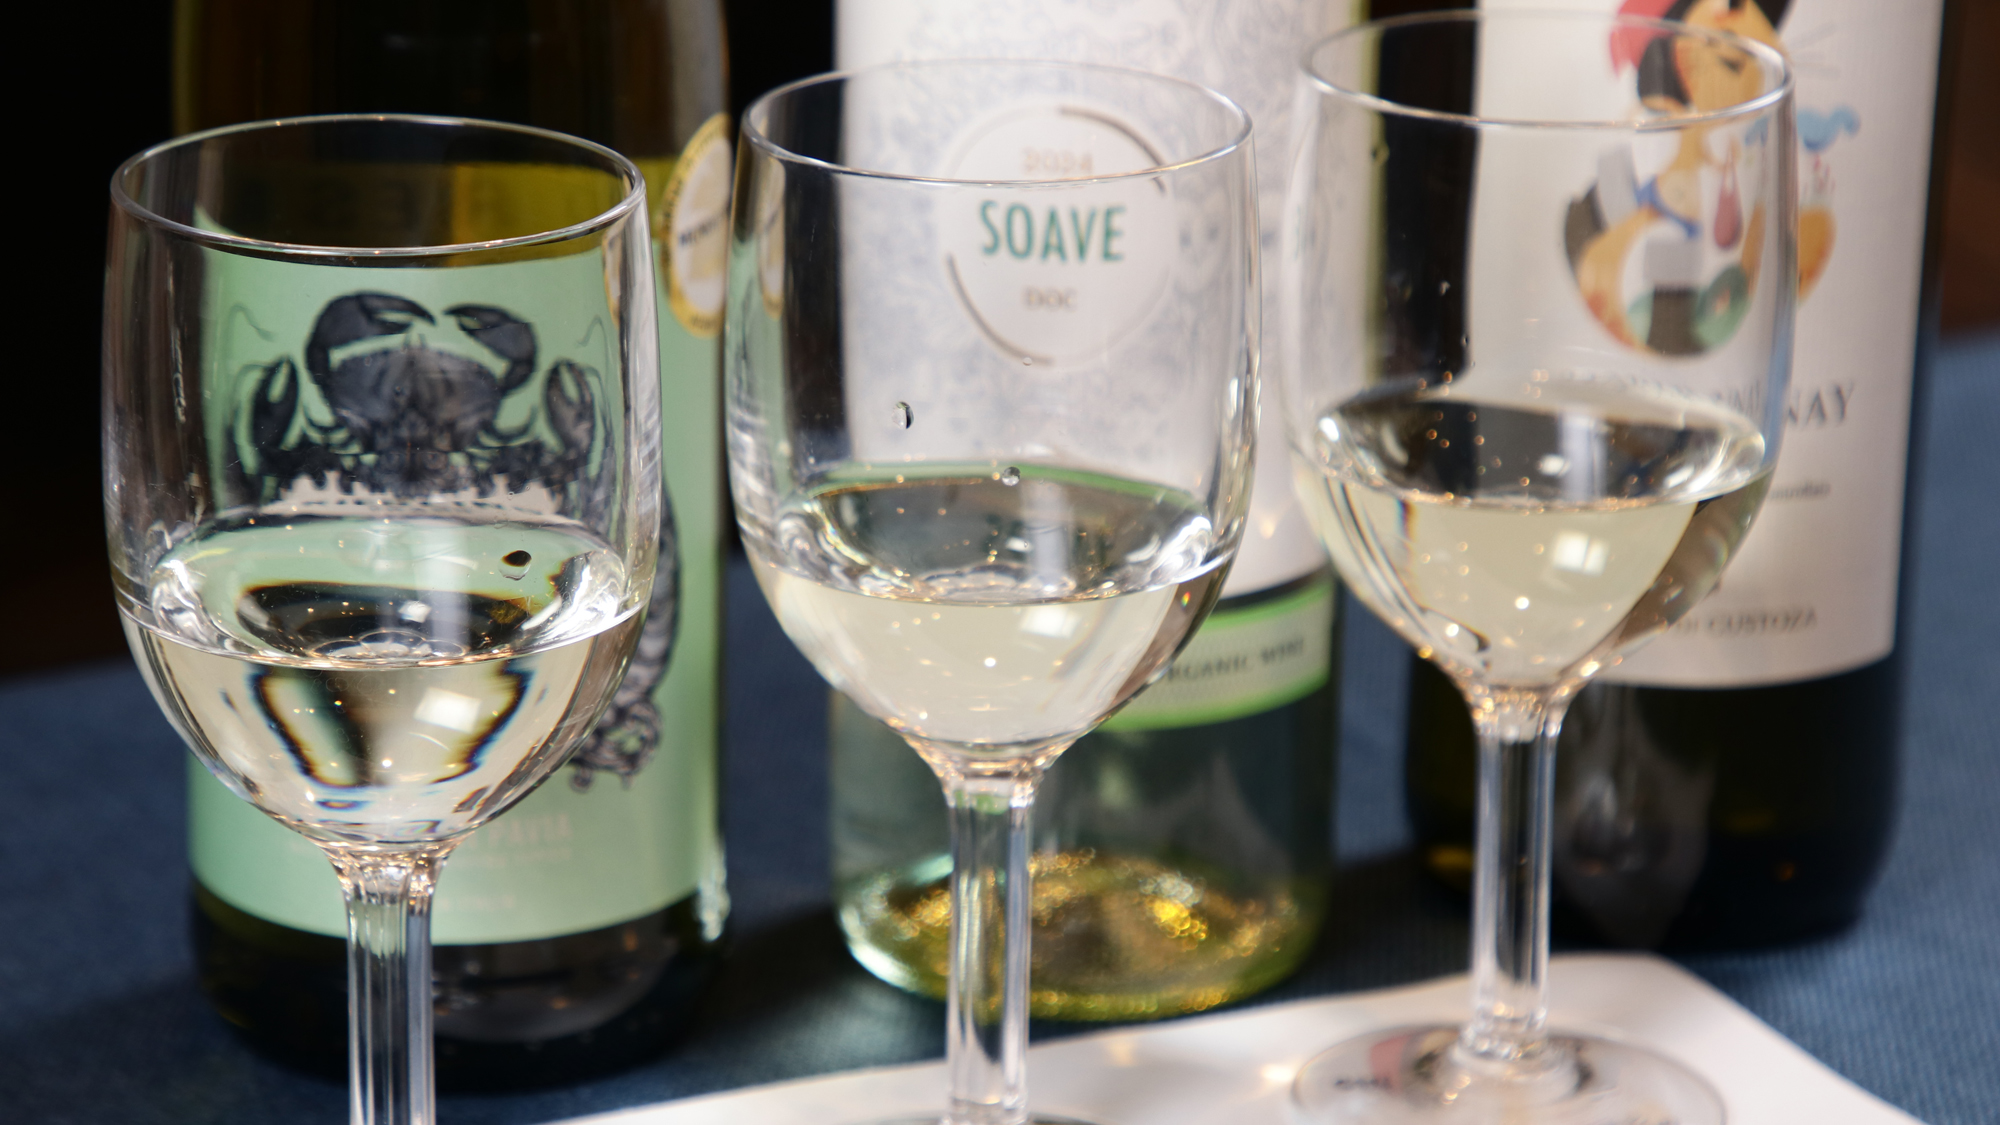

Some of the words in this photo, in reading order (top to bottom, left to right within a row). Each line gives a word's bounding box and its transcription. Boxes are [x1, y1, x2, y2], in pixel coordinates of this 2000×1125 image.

[979, 200, 1127, 263] SOAVE
[1023, 288, 1078, 311] DOC
[1166, 655, 1249, 681] RGANIC
